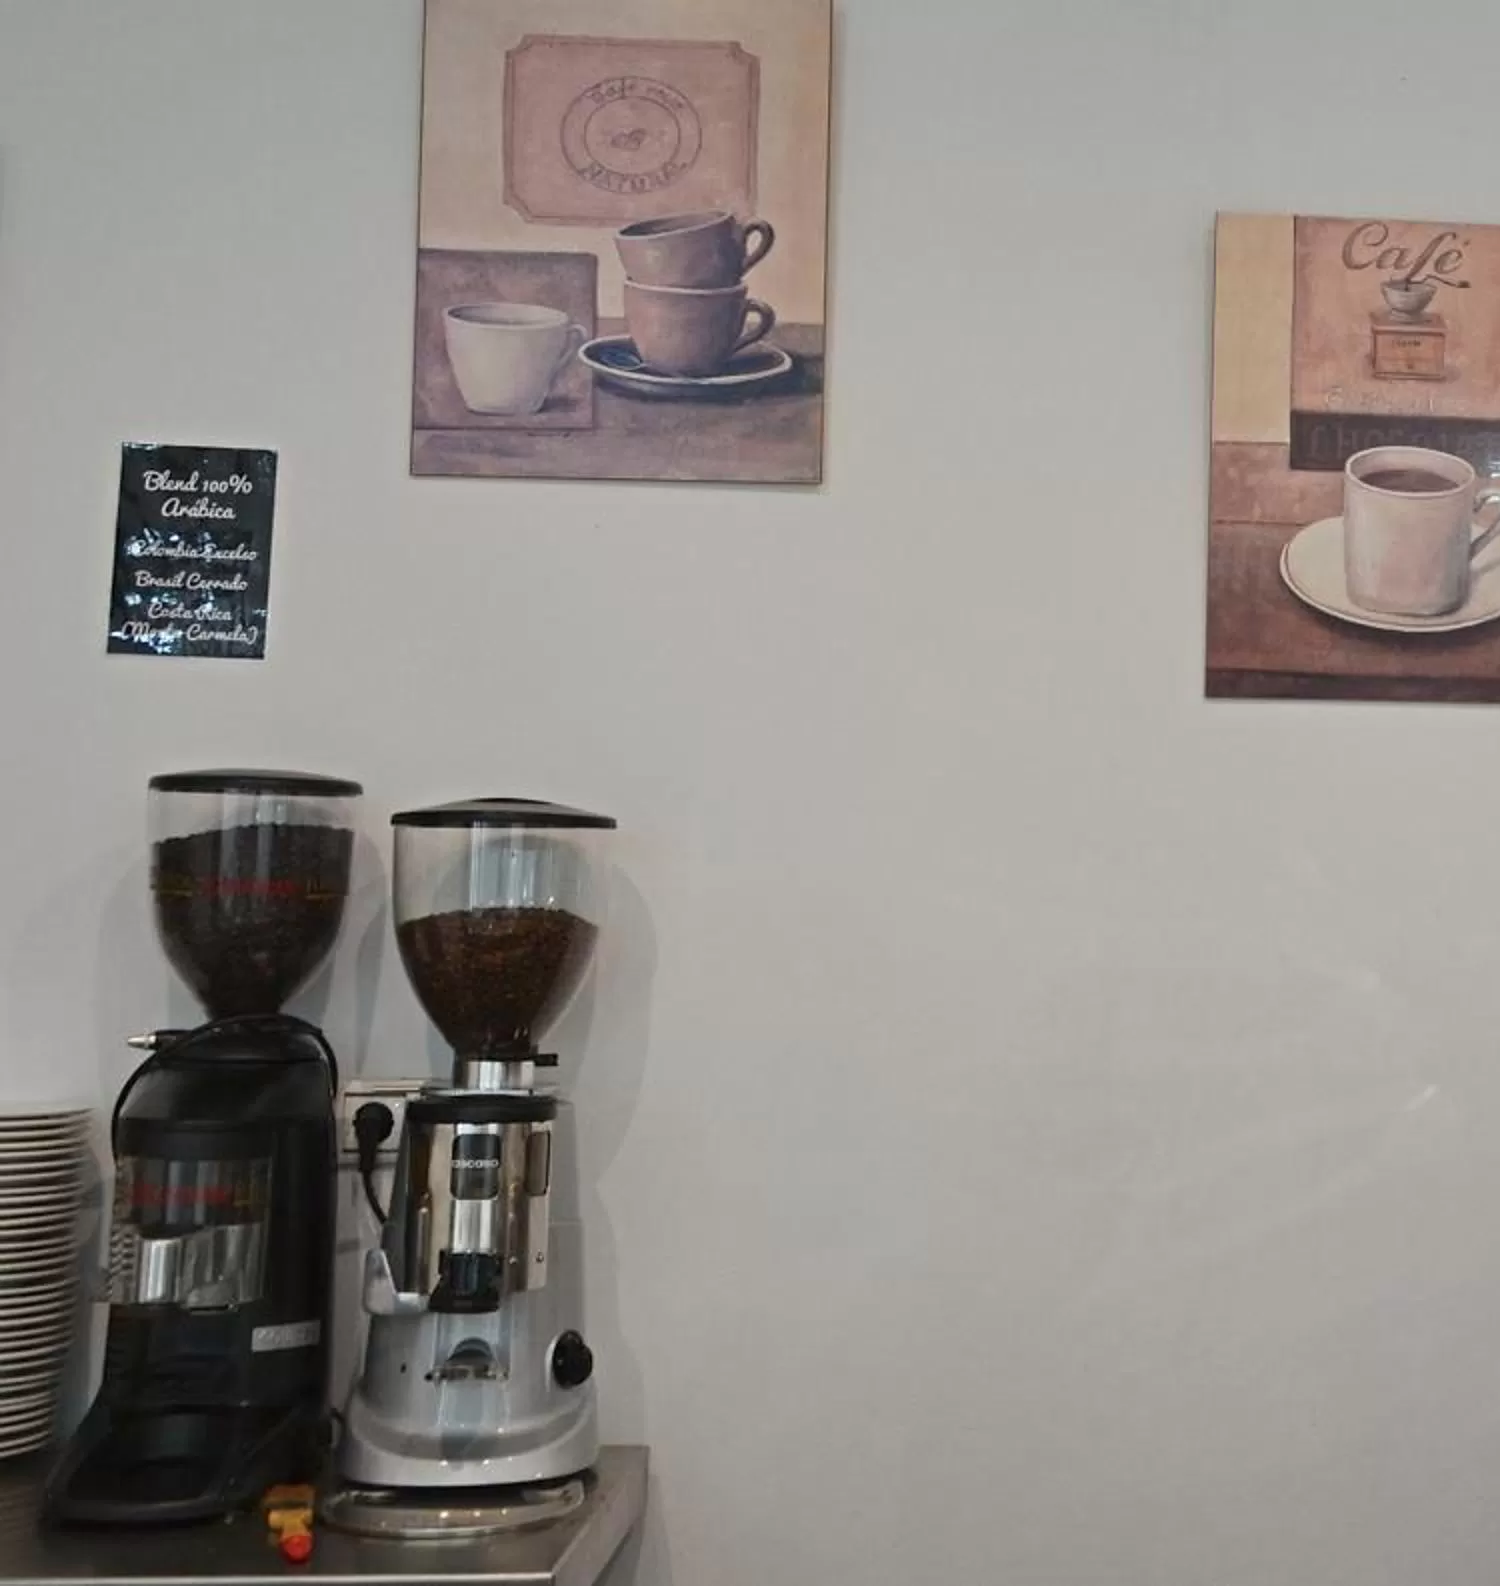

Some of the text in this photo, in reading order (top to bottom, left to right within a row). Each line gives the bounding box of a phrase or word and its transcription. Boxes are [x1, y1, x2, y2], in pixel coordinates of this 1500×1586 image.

[1341, 220, 1471, 284] Café
[143, 470, 253, 494] Blend 100%
[134, 569, 248, 591] Brasil Cerrado
[148, 601, 232, 621] Costa Rica
